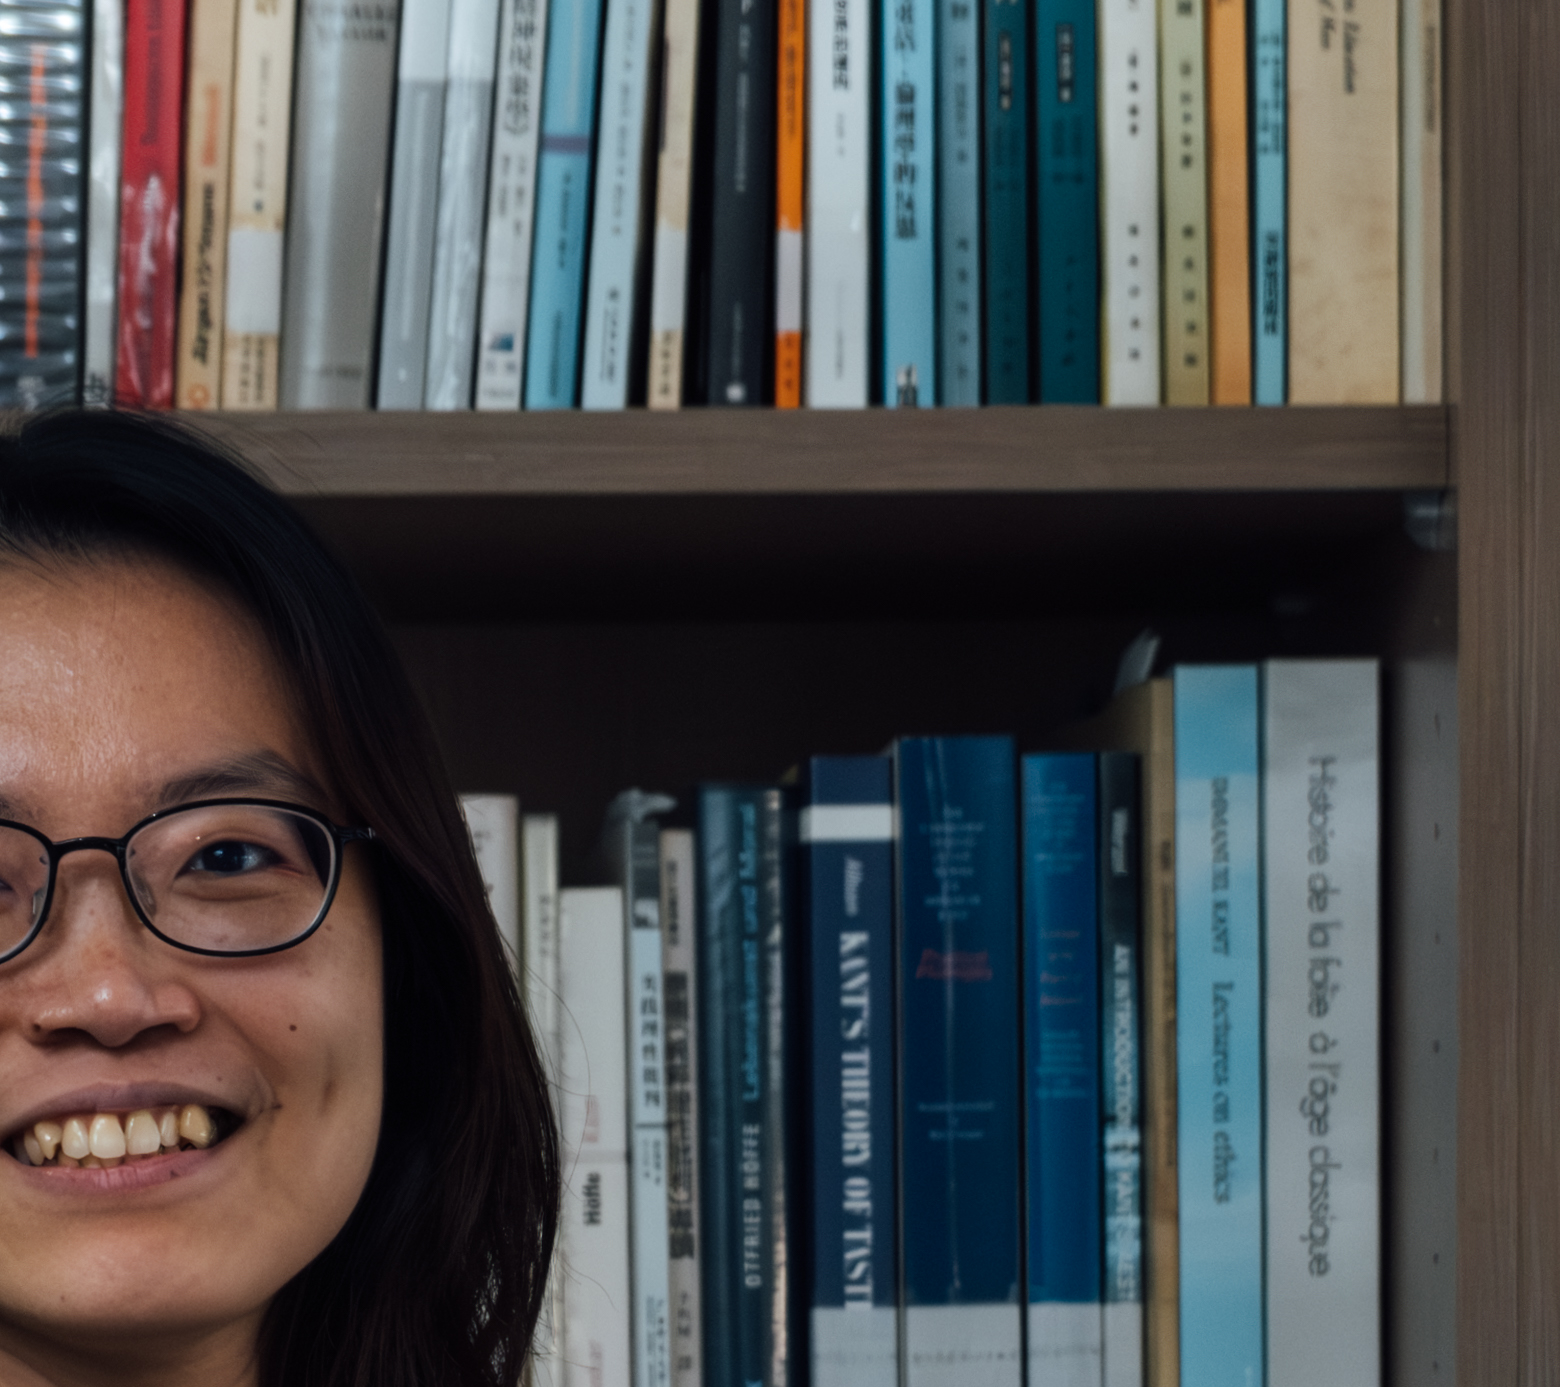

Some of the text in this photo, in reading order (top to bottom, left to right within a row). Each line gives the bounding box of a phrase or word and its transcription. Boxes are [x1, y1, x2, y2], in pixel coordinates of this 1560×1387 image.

[1308, 757, 1341, 868] Histoire
[1308, 874, 1341, 914] de
[1308, 923, 1341, 950] la
[1308, 958, 1341, 1018] folie
[839, 931, 872, 1217] KANT'S THEORY OF
[1213, 1131, 1236, 1204] ethics
[1300, 1147, 1342, 1278] classique
